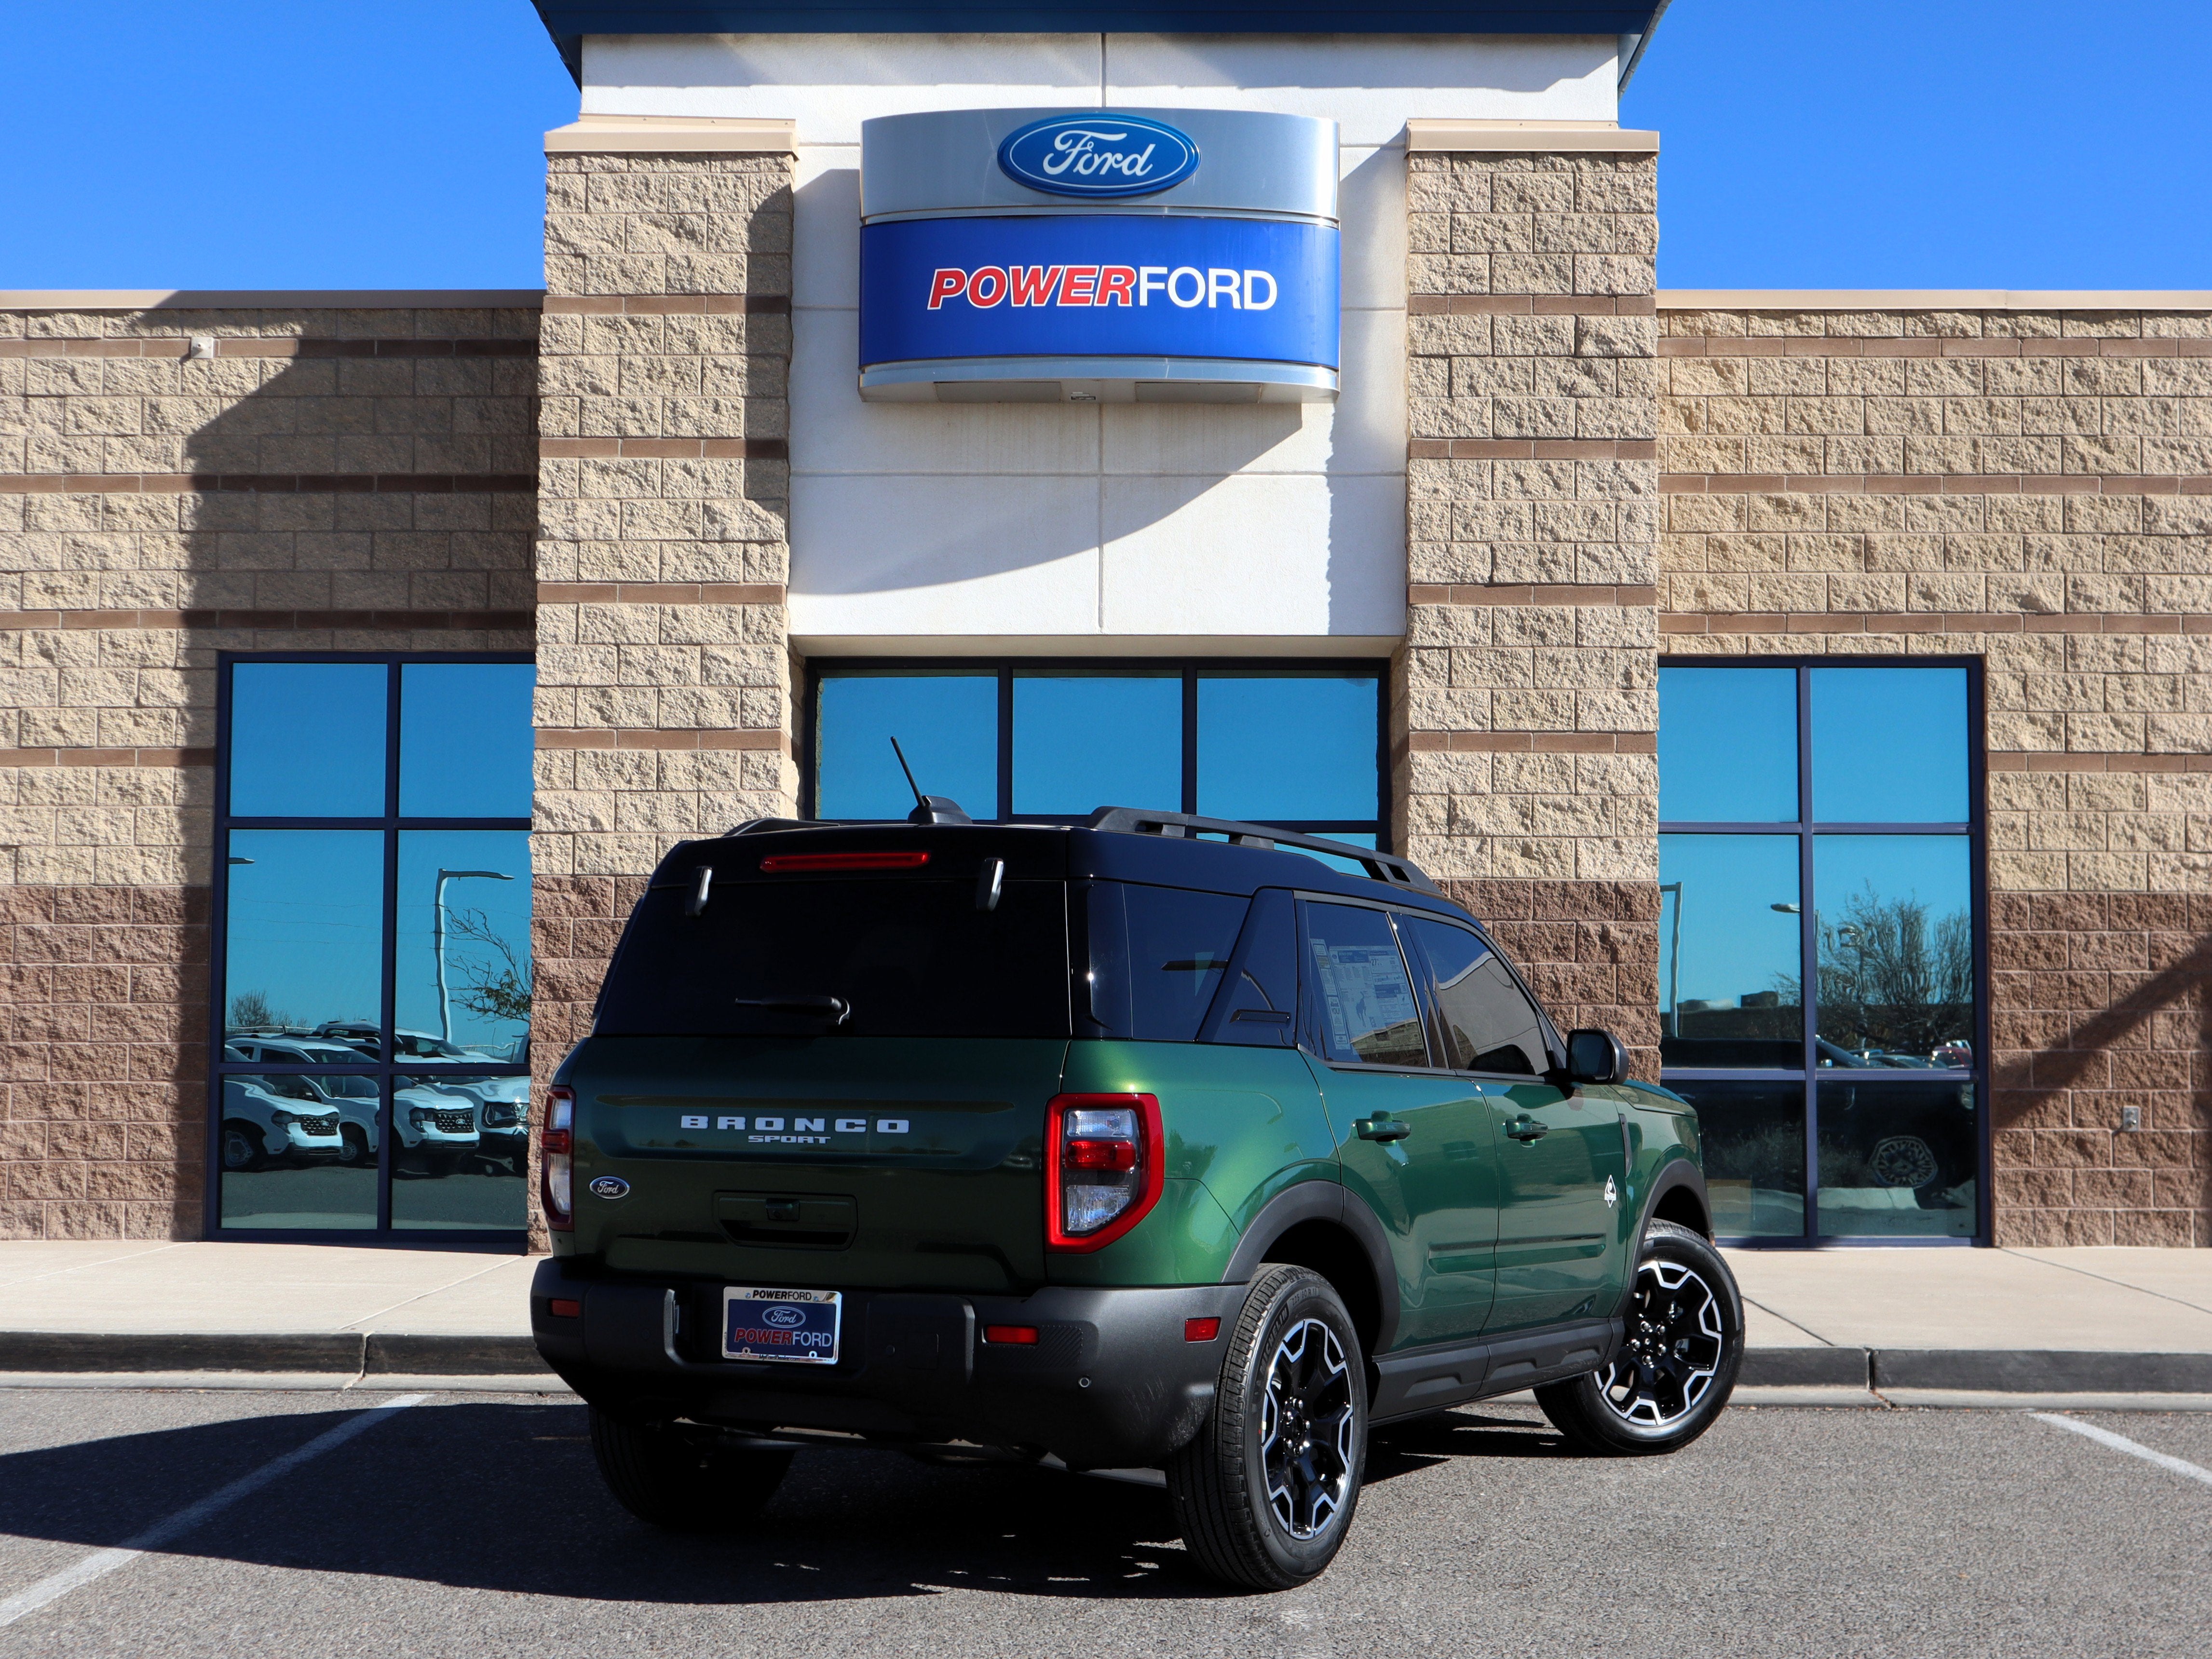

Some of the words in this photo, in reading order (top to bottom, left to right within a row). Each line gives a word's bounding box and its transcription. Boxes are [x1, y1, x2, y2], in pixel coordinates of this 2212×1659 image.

[1043, 129, 1155, 176] Ford
[681, 1115, 909, 1133] BRONCO
[748, 1135, 831, 1144] SPORT
[597, 1180, 619, 1194] Ford
[752, 1290, 812, 1301] POWERFORD
[771, 1310, 797, 1323] Ford
[734, 1328, 832, 1347] POWERFORD
[1260, 1306, 1288, 1376] MICHELIN
